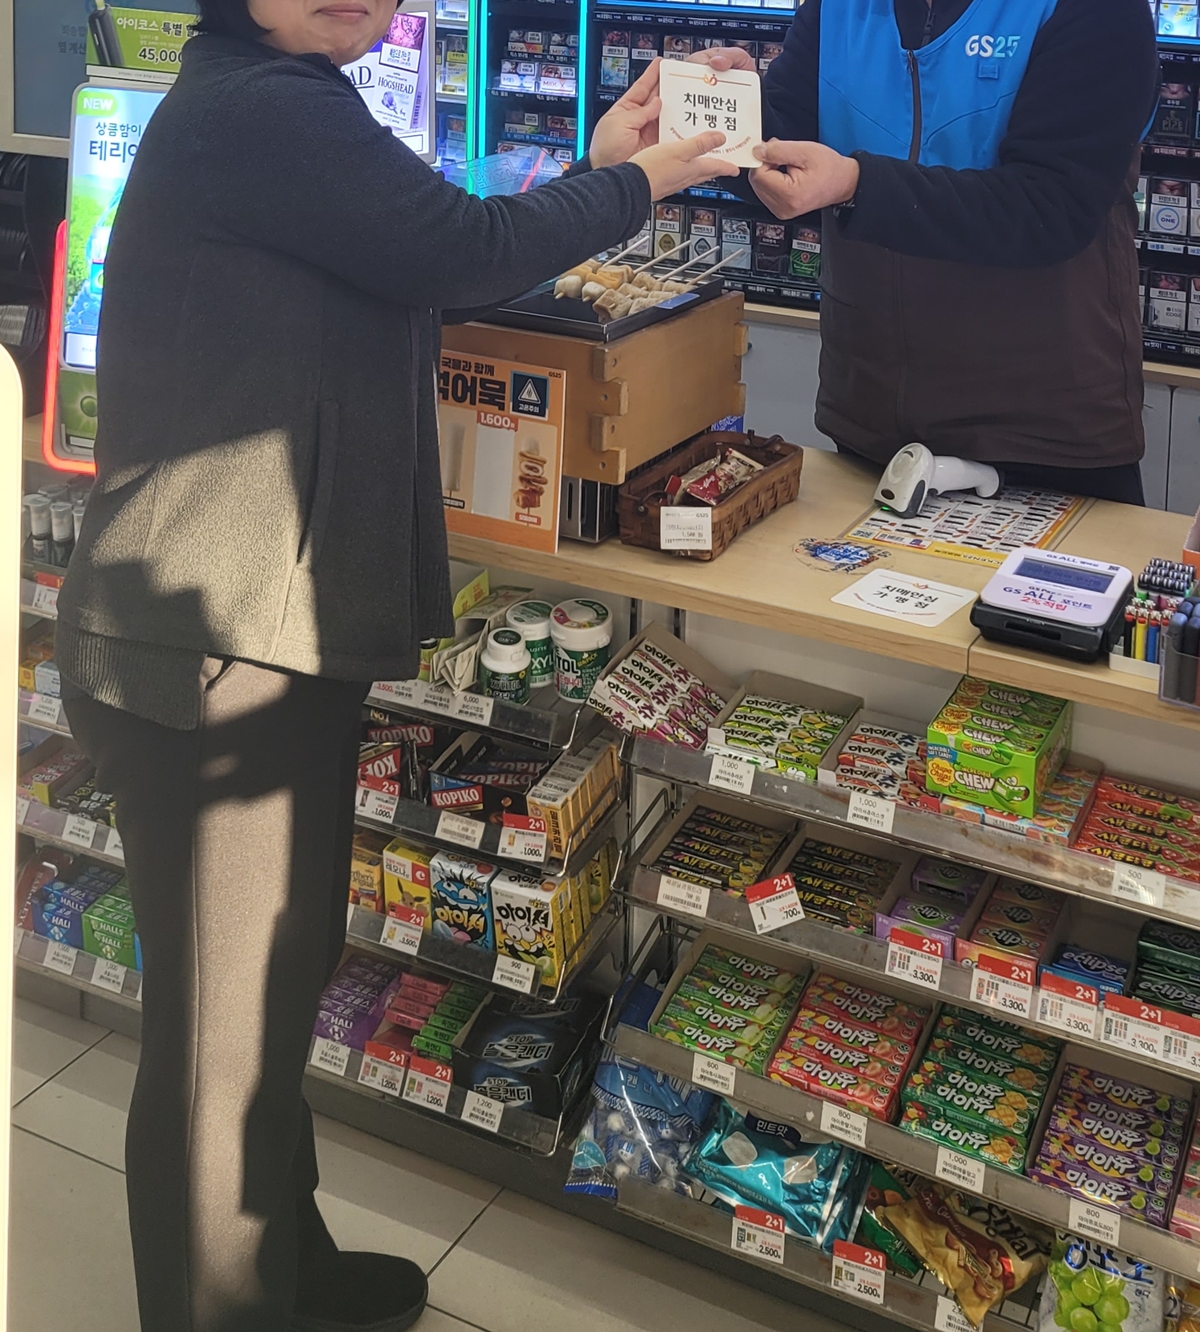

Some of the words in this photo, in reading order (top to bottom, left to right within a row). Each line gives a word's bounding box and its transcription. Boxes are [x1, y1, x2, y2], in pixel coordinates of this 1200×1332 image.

[117, 17, 159, 32] 아이코스
[161, 22, 183, 36] 특별
[965, 34, 1021, 58] GS25
[378, 76, 414, 95] HOGSHEAD
[83, 97, 113, 110] NEW
[684, 92, 737, 113] 치매안심
[95, 122, 142, 137] 상큼함이
[474, 361, 495, 376] 함께
[881, 584, 939, 603] 치매안심
[1024, 590, 1056, 602] ALL
[1061, 598, 1093, 609] 포인트
[990, 689, 1031, 704] CHEW
[982, 702, 1024, 717] CHEW
[972, 716, 1014, 730] CHEW
[370, 725, 431, 744] KOPIKO
[963, 728, 1006, 743] CHEW
[972, 746, 991, 756] CHEW
[721, 760, 738, 770] 1,000
[931, 762, 952, 774] Chupa
[930, 769, 951, 782] Chups
[955, 771, 995, 790] CHEW
[382, 782, 399, 795] 2+1
[433, 788, 479, 807] KOPIKO
[859, 797, 876, 808] 1,000
[529, 819, 545, 831] 2+1
[773, 875, 792, 891] 2+1
[1128, 870, 1142, 880] 500
[60, 896, 84, 913] HALLS
[410, 914, 424, 926] 2+1
[907, 904, 954, 922] eclipse
[99, 923, 124, 936] HALLS
[979, 927, 1040, 949] eclipse
[922, 939, 942, 955] 2+1
[511, 961, 522, 969] 900
[729, 956, 778, 979] 마이쮸
[1063, 951, 1127, 975] eclipse
[1011, 966, 1031, 983] 2+1
[1075, 986, 1096, 1003] 2+1
[695, 1006, 746, 1031] 마이쮸
[1140, 1006, 1161, 1023] 2+1
[508, 1035, 533, 1043] STOP
[684, 1026, 735, 1052] 마이쮸
[825, 1019, 877, 1046] 마이쮸
[966, 1026, 1022, 1053] 마이쮸
[389, 1051, 405, 1065] 2+1
[706, 1060, 718, 1070] 800
[435, 1065, 451, 1080] 2+1
[803, 1061, 857, 1088] 마이쮸
[1094, 1077, 1153, 1105] 마이쮸
[477, 1098, 492, 1108] 1,200
[838, 1110, 850, 1120] 800
[756, 1120, 789, 1137] 민트맛
[931, 1119, 990, 1150] 마이쮸
[1066, 1169, 1128, 1201] 마이쮸
[1085, 1207, 1100, 1219] 800
[765, 1215, 784, 1230] 2+1
[864, 1251, 884, 1268] 2+1
